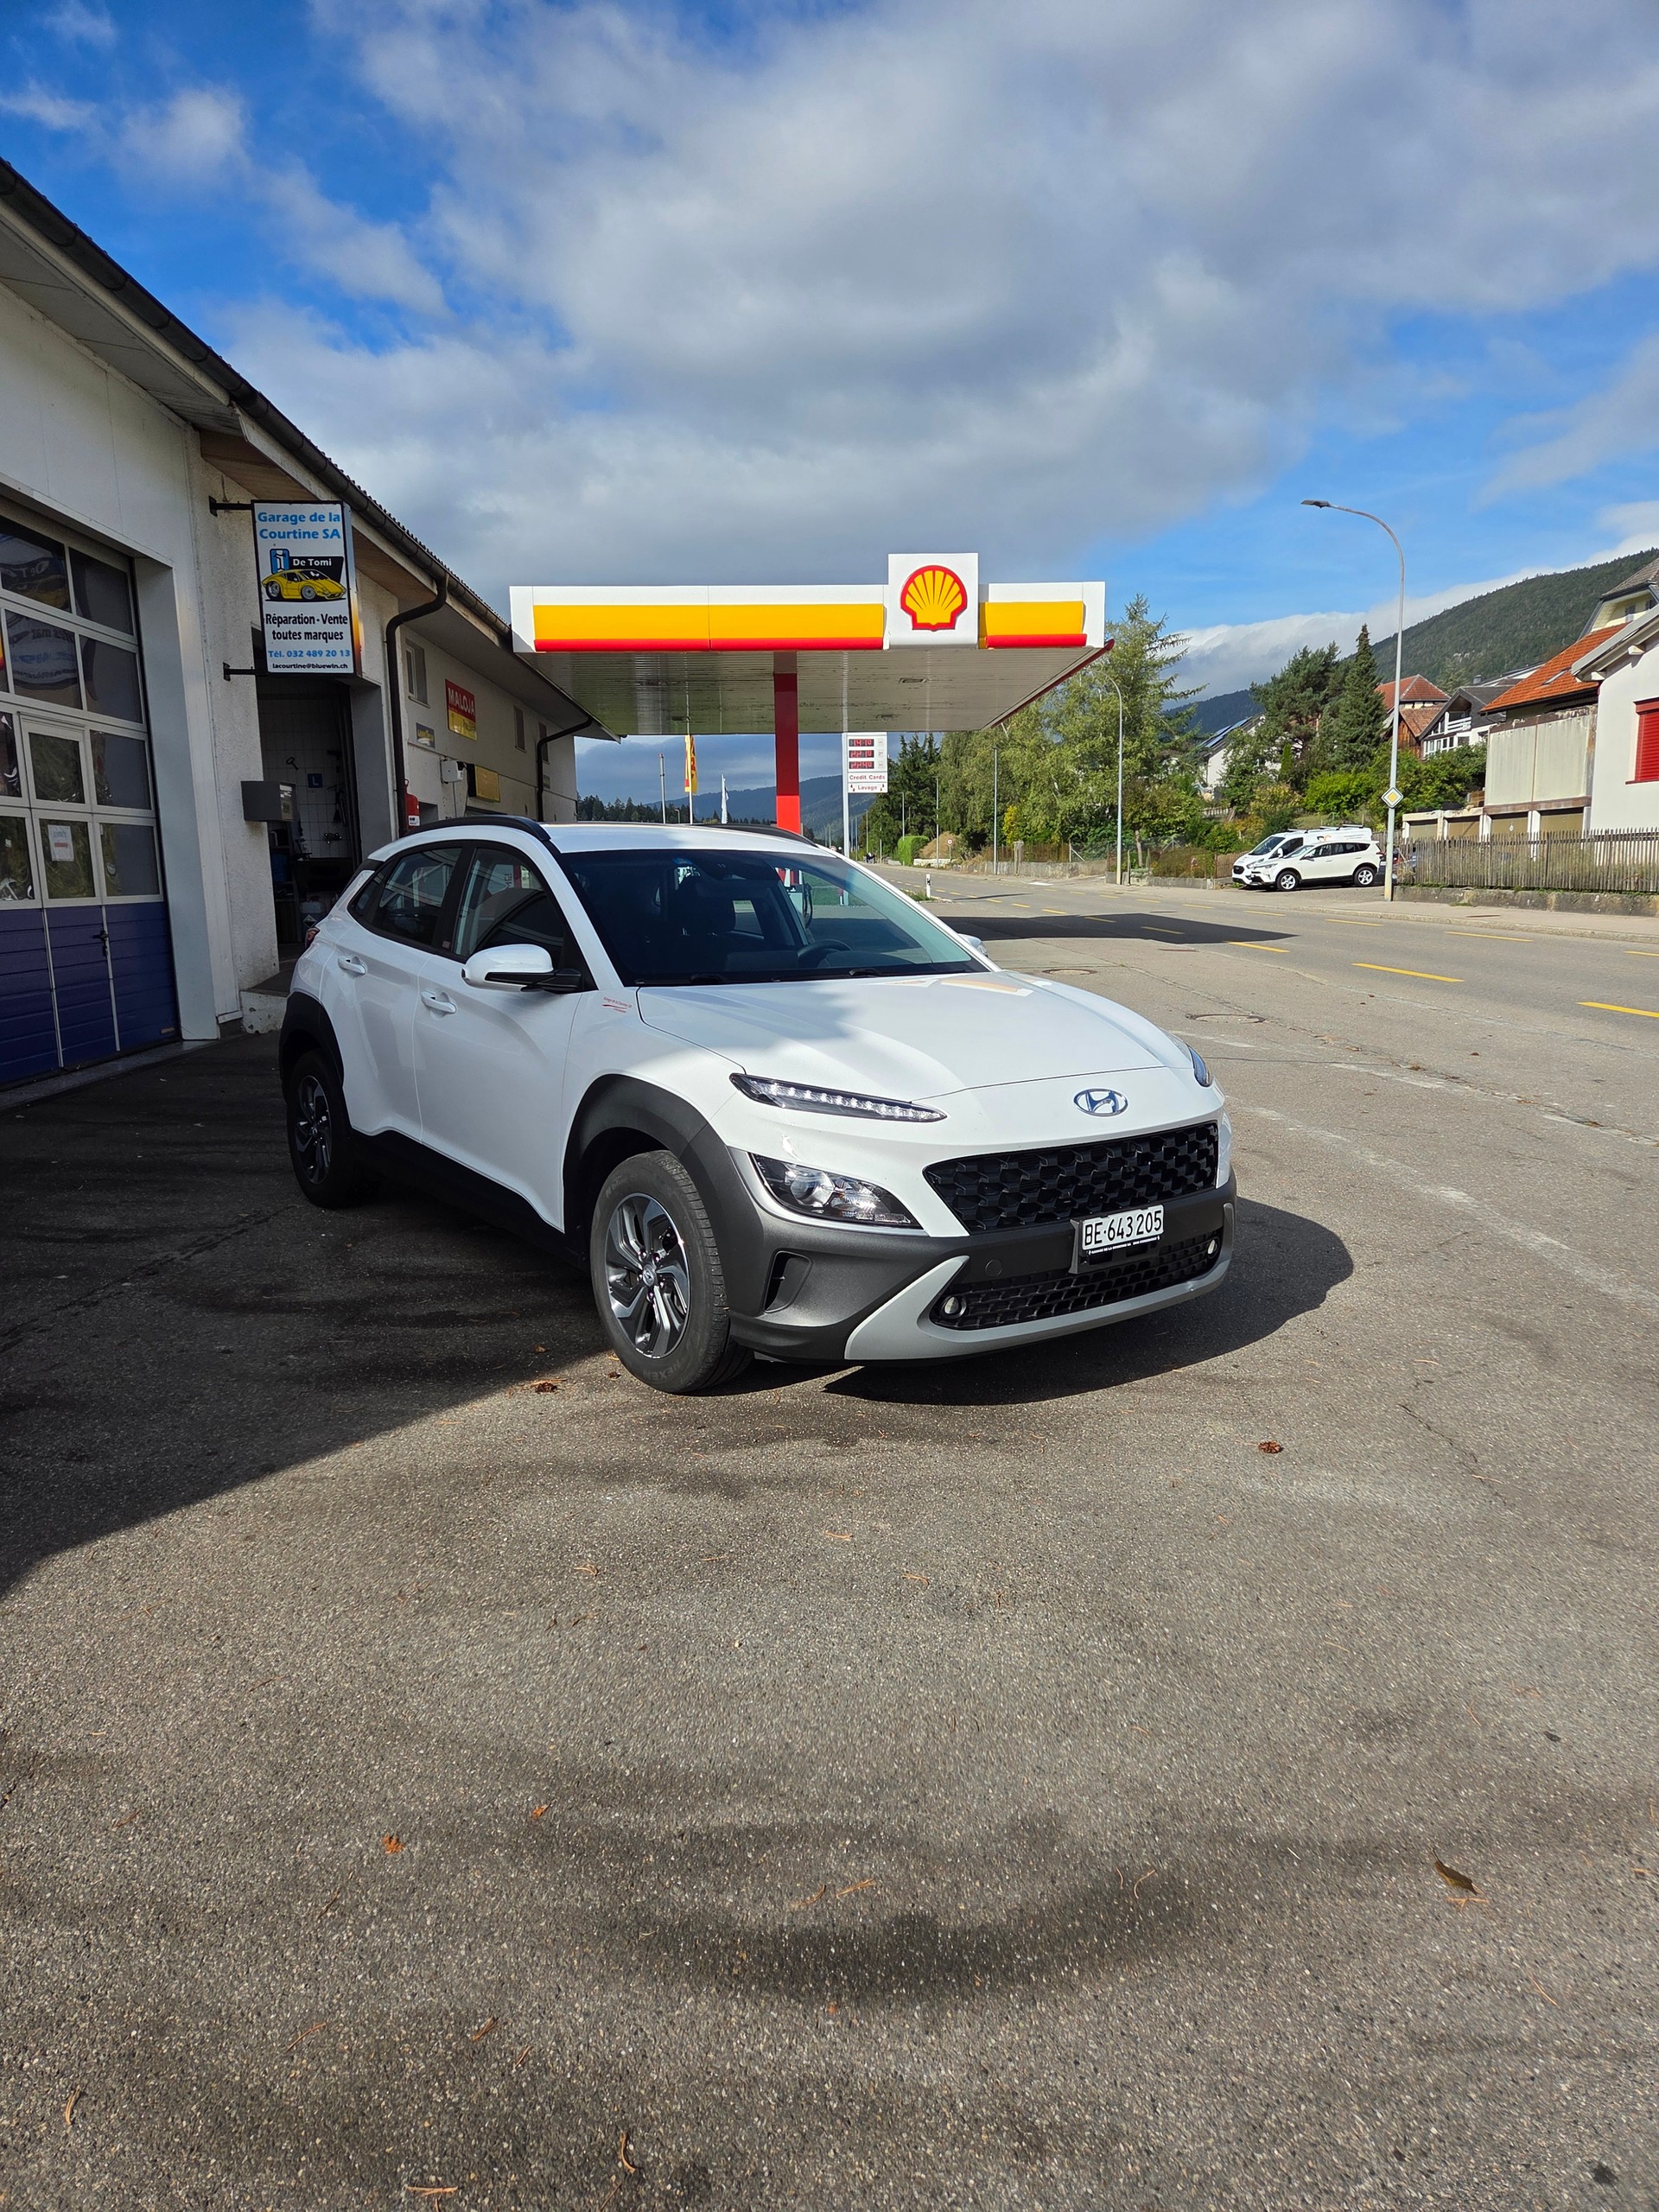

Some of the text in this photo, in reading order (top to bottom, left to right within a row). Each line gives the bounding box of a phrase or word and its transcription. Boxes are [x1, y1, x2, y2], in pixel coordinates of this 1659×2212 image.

[257, 512, 340, 525] Garage de la
[259, 529, 340, 539] Courtine SA
[265, 613, 315, 627] Réparation
[321, 613, 348, 625] Vente
[272, 630, 344, 644] toutes marques
[448, 687, 475, 716] MALOJA
